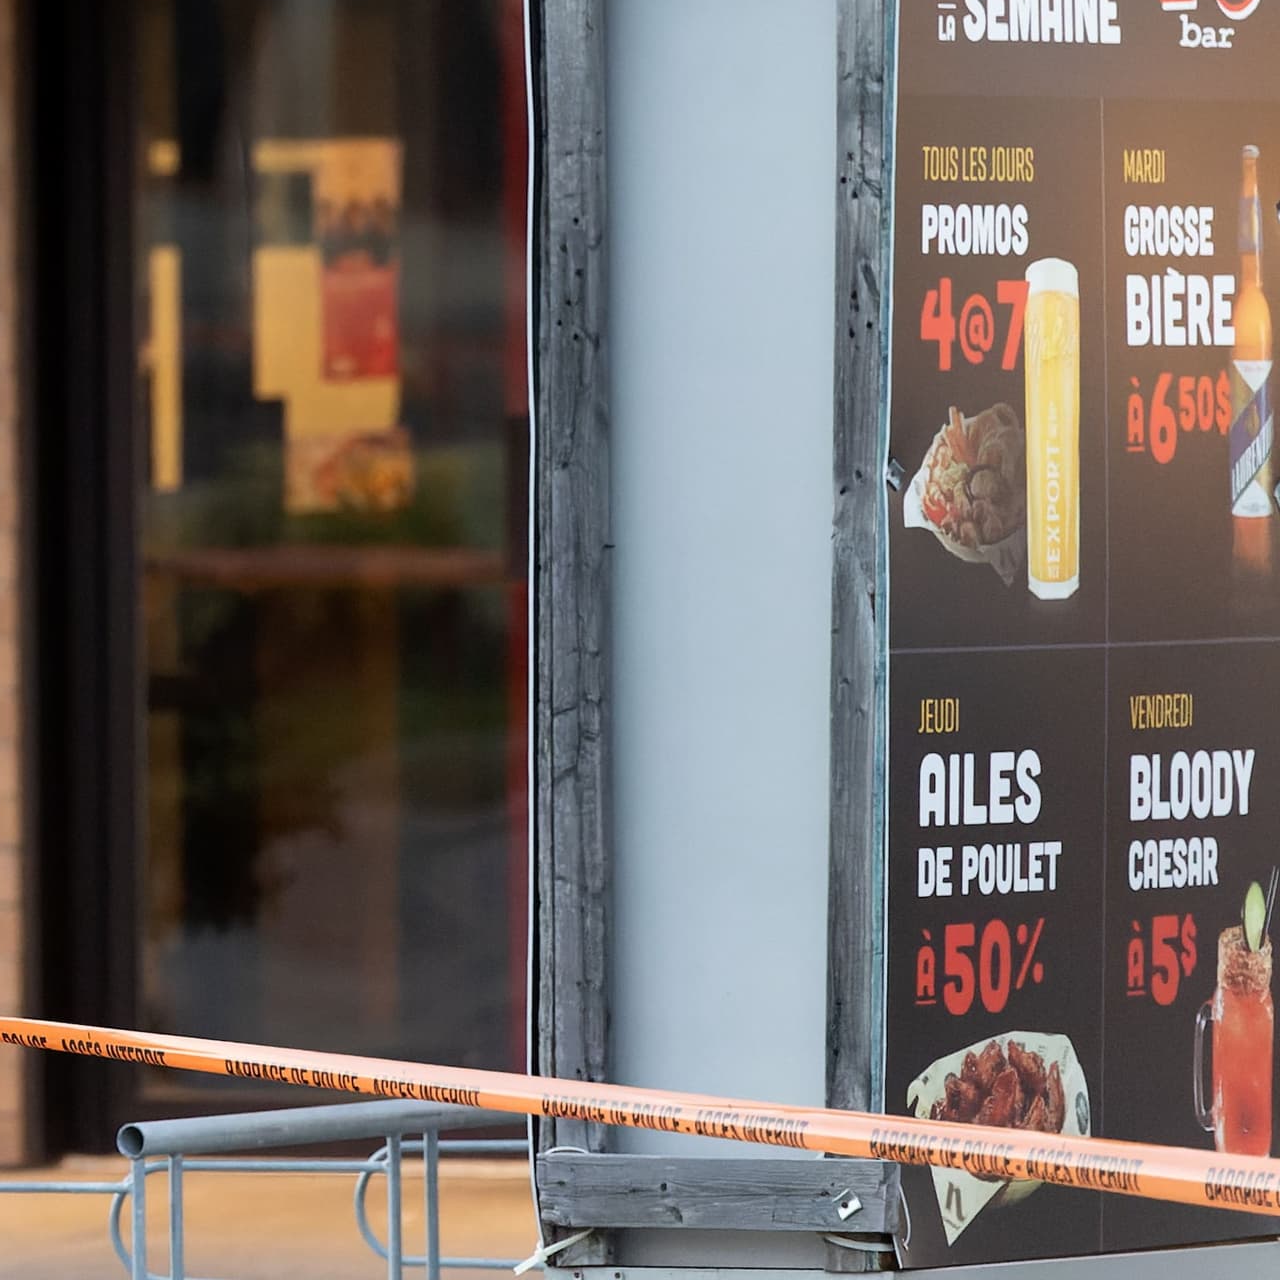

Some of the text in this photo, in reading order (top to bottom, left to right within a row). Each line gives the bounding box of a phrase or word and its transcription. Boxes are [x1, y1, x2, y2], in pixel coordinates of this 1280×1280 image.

[938, 16, 955, 41] LA
[1179, 15, 1235, 48] bar
[922, 146, 1034, 182] TOUS LES JOURS
[1124, 149, 1165, 183] MARDI
[921, 204, 1028, 255] PROMOS
[1125, 205, 1214, 256] GROSSE
[921, 277, 1030, 371] 4@7
[1126, 267, 1236, 346] BIÈRE
[1046, 440, 1060, 563] EXPORT
[918, 698, 959, 733] JEUDI
[1130, 693, 1193, 729] VENDREDI
[919, 749, 1042, 827] AILES
[1129, 749, 1255, 821] BLOODY
[917, 841, 1062, 898] DE POULET
[1128, 836, 1219, 891] CAESAR
[1205, 1167, 1275, 1207] BARRAGE
